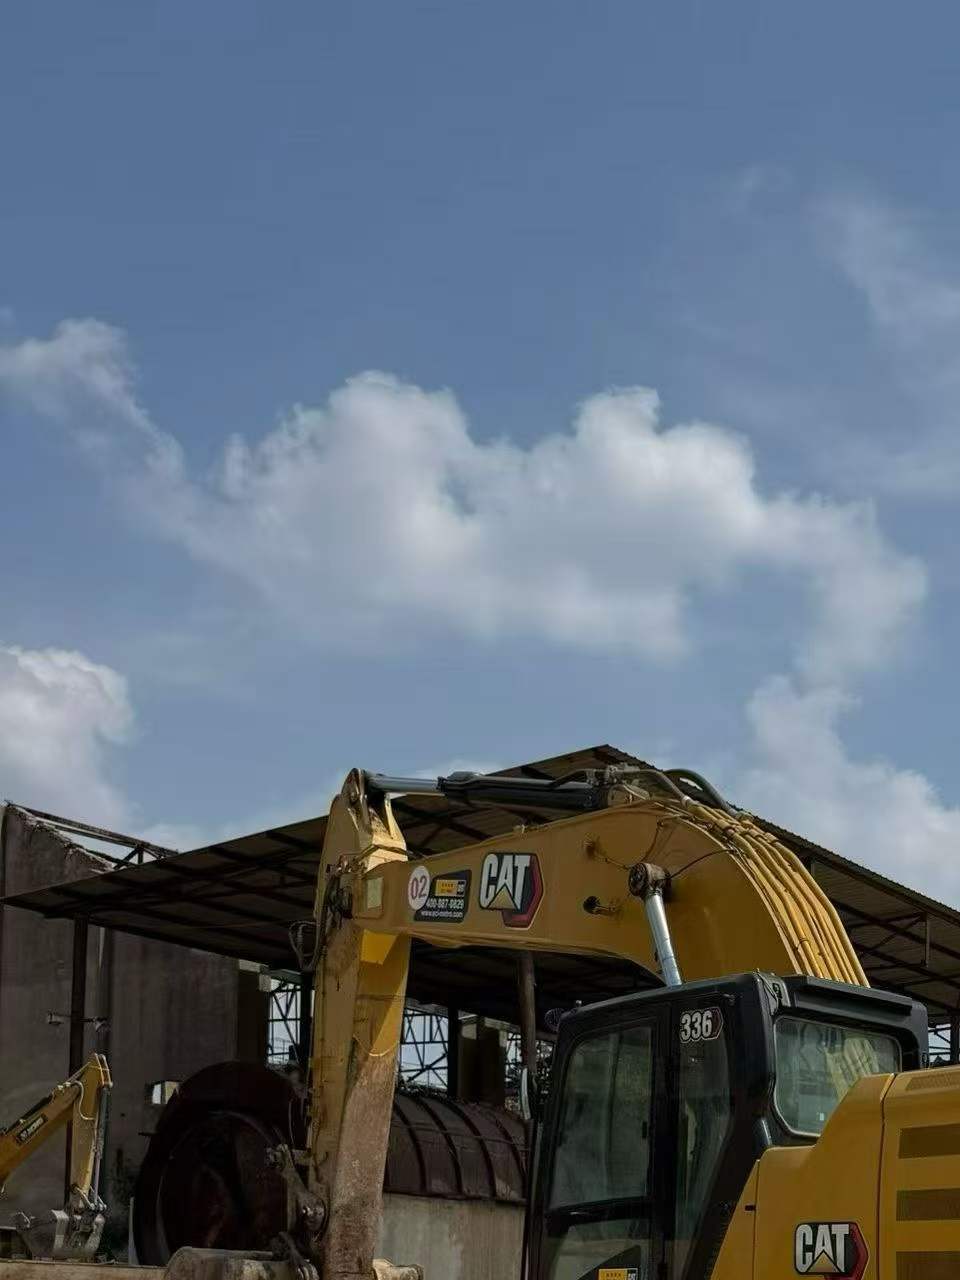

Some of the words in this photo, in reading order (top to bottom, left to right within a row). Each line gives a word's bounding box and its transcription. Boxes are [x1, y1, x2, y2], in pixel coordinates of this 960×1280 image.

[411, 875, 428, 900] 02
[480, 853, 531, 911] CAT
[681, 1010, 712, 1041] 336
[796, 1223, 850, 1273] CAT
